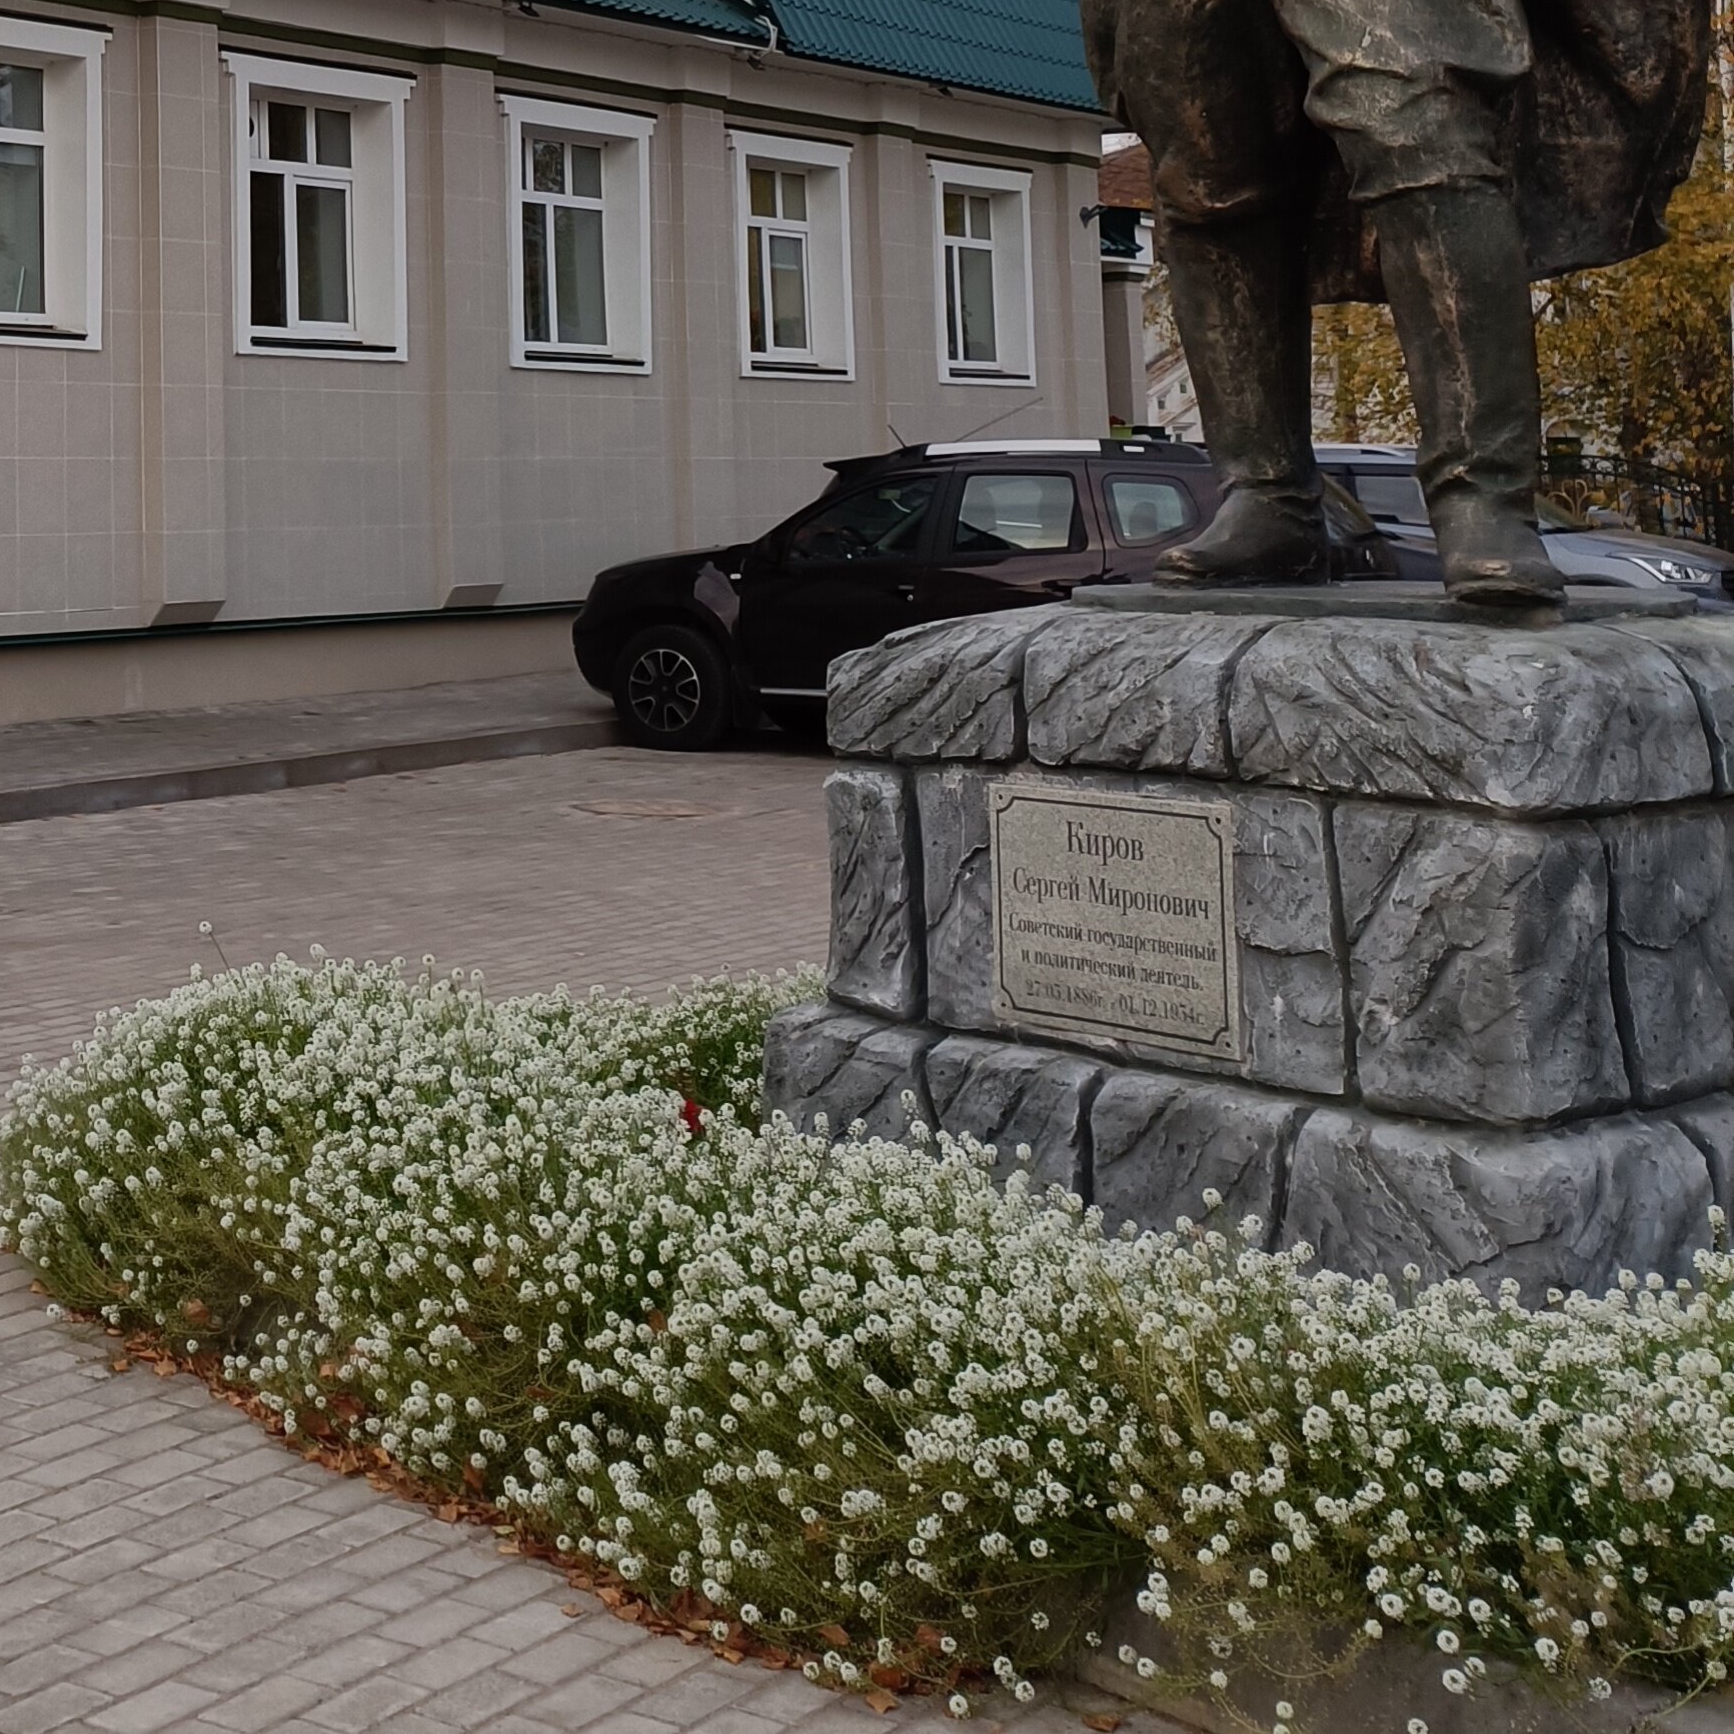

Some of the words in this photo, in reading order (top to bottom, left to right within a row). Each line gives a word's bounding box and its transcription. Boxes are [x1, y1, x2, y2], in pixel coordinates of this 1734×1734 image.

[1066, 821, 1144, 865] Киров
[1013, 867, 1080, 903] Сергей
[1088, 876, 1209, 919] Миронович
[1009, 912, 1082, 942] Советский
[1087, 928, 1217, 963] государственный
[1021, 949, 1030, 963] и
[1034, 951, 1136, 980] политический
